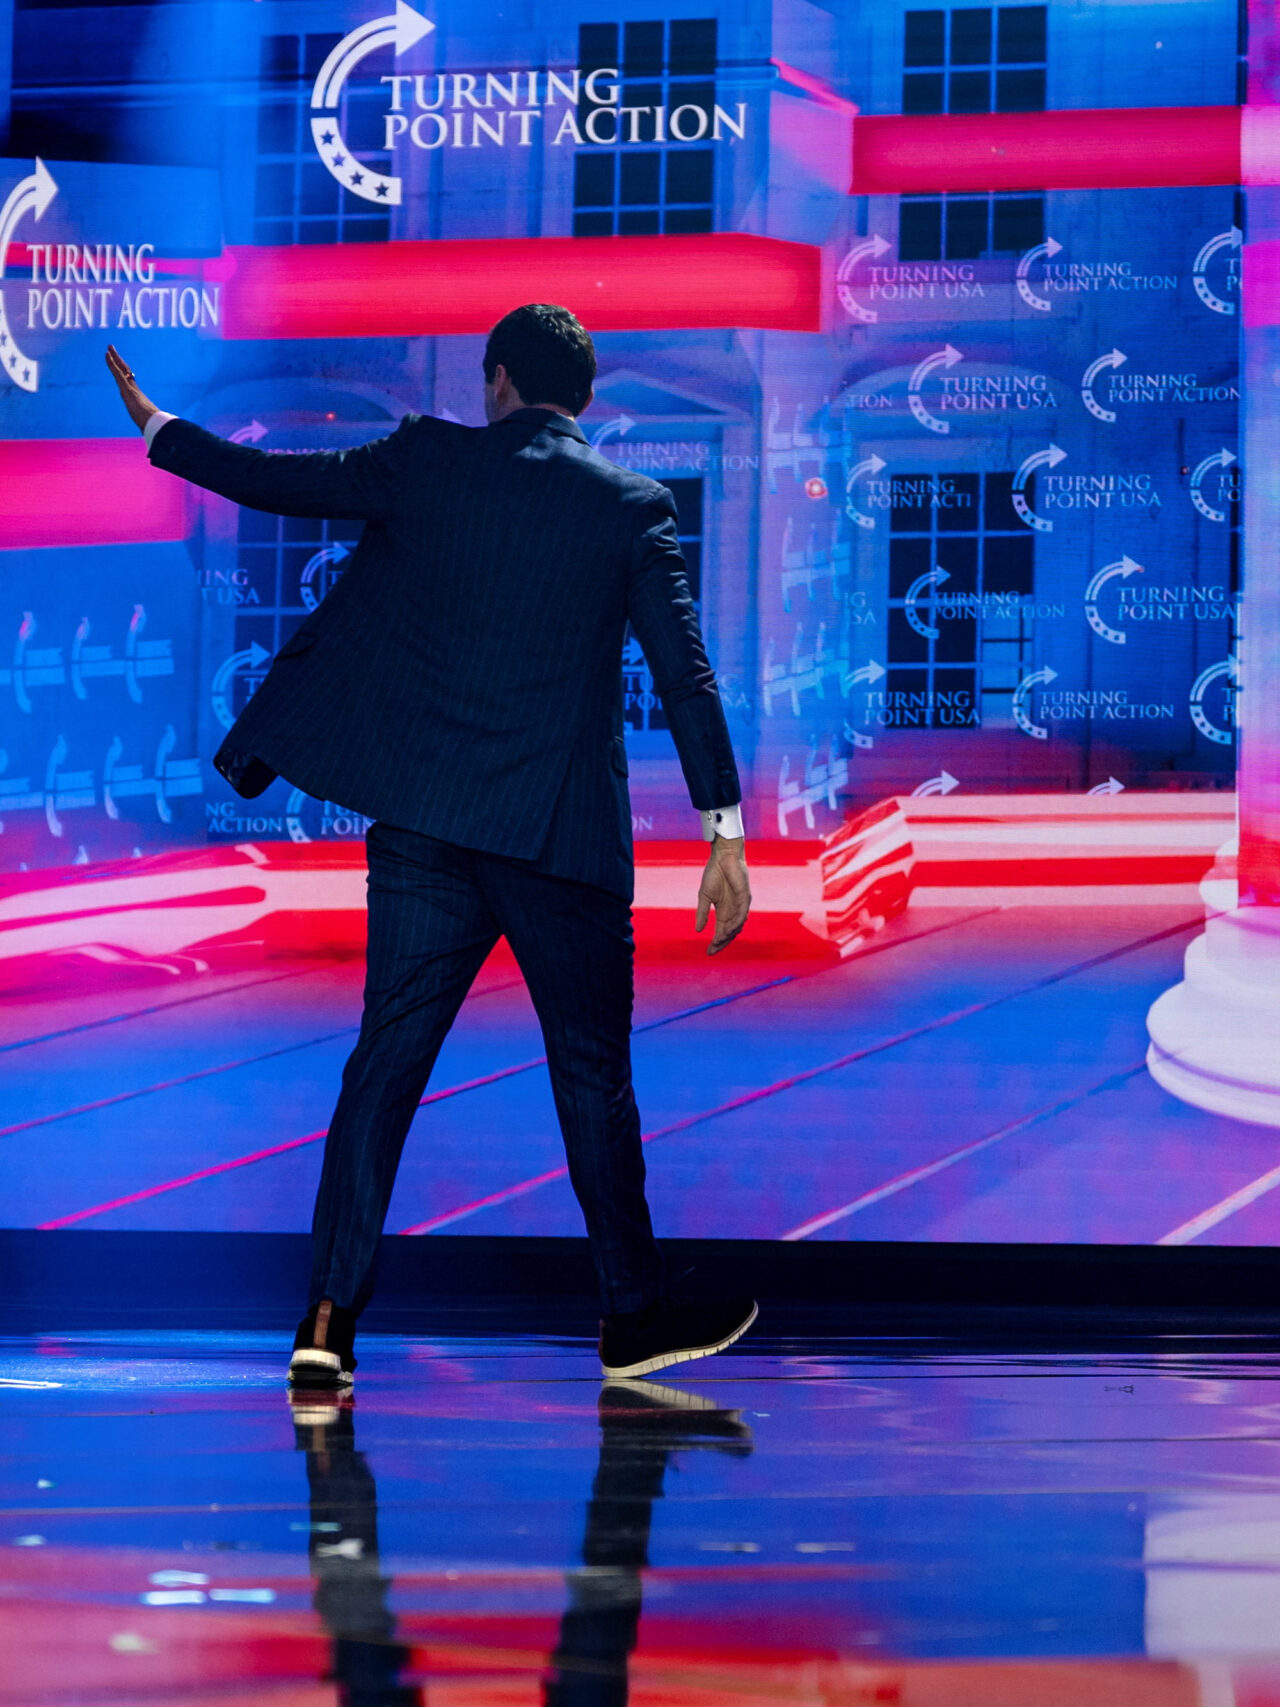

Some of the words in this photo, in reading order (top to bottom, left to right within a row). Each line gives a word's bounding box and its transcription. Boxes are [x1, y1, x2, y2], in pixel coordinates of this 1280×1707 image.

[381, 68, 620, 111] TURNING
[383, 110, 541, 150] POINT
[551, 103, 748, 146] ACTION
[26, 243, 156, 284] TURNING
[1043, 262, 1132, 278] TURNING
[868, 264, 975, 283] TURNING
[869, 282, 939, 300] POINT
[943, 281, 986, 298] USA
[1044, 277, 1102, 292] POINT
[1105, 275, 1178, 291] ACTION
[27, 287, 112, 330] POINT
[117, 286, 220, 329] ACTION
[940, 374, 1047, 392] TURNING
[1108, 373, 1197, 389] TURNING
[940, 393, 1012, 410] POINT
[1016, 392, 1058, 409] USA
[1108, 387, 1169, 403] POINT
[1172, 386, 1241, 402] ACTION
[615, 441, 711, 456] TURNING
[616, 456, 680, 470] POINT
[686, 454, 760, 471] ACTION
[866, 479, 955, 495] TURNING
[1043, 474, 1152, 492] TURNING
[867, 493, 928, 508] POINT
[1044, 491, 1116, 509] POINT
[1120, 490, 1163, 508] USA
[217, 587, 260, 604] USA
[933, 591, 1020, 606] TURNING
[1117, 585, 1224, 602] TURNING
[934, 605, 988, 620] POINT
[995, 605, 1065, 620] ACTION
[1117, 603, 1189, 621] POINT
[1193, 602, 1236, 620] USA
[863, 690, 970, 708] TURNING
[1039, 690, 1128, 706] TURNING
[864, 708, 935, 726] POINT
[939, 707, 982, 725] USA
[1039, 704, 1100, 720] POINT
[1102, 703, 1175, 719] ACTION
[207, 817, 283, 834] ACTION
